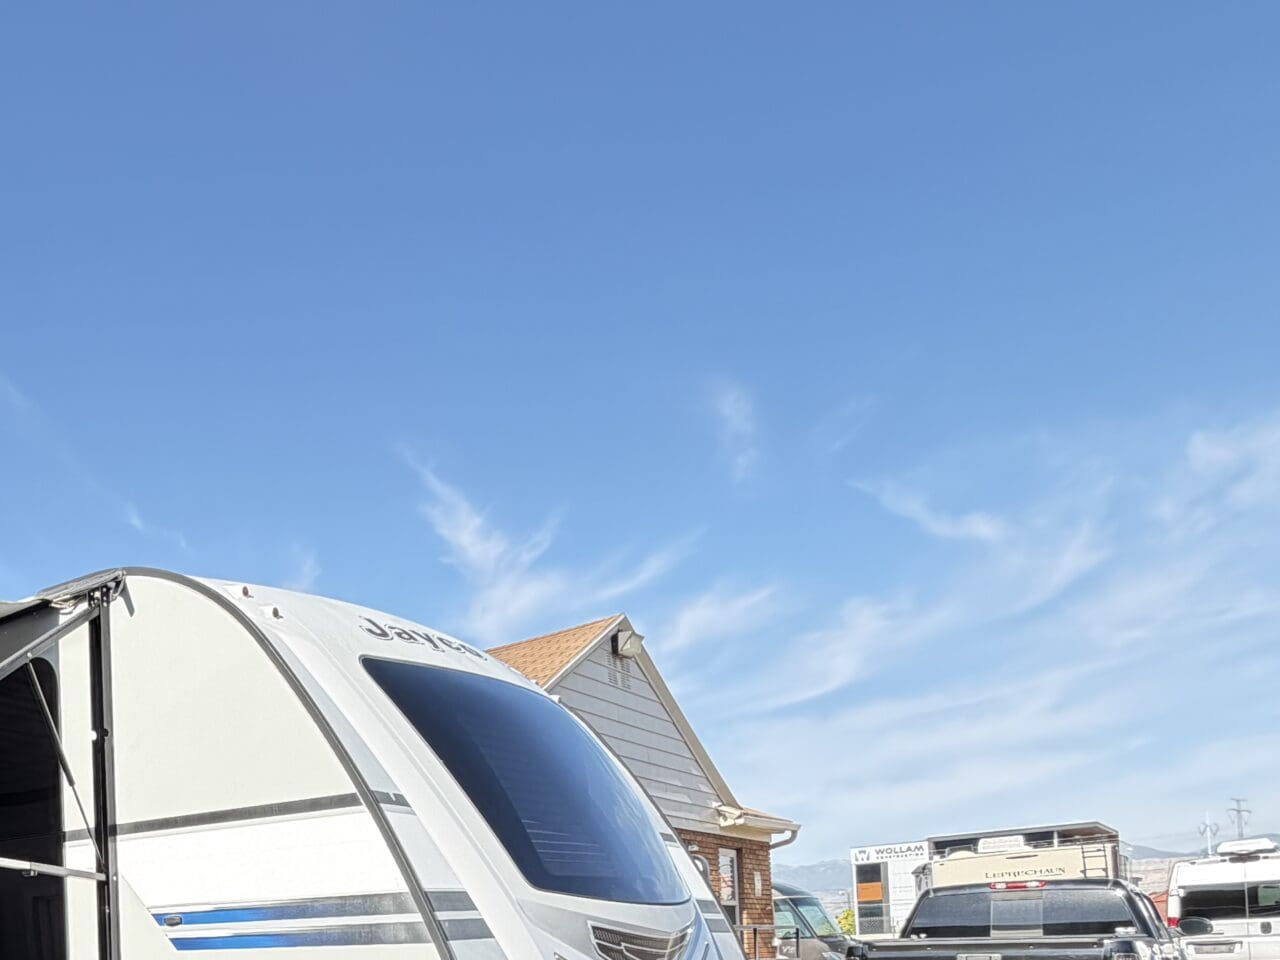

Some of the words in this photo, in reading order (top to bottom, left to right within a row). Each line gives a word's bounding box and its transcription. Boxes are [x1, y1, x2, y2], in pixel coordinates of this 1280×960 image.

[358, 614, 486, 661] Jayco
[874, 844, 925, 855] WOLLAM
[985, 867, 1066, 879] LEPRECHAUN
